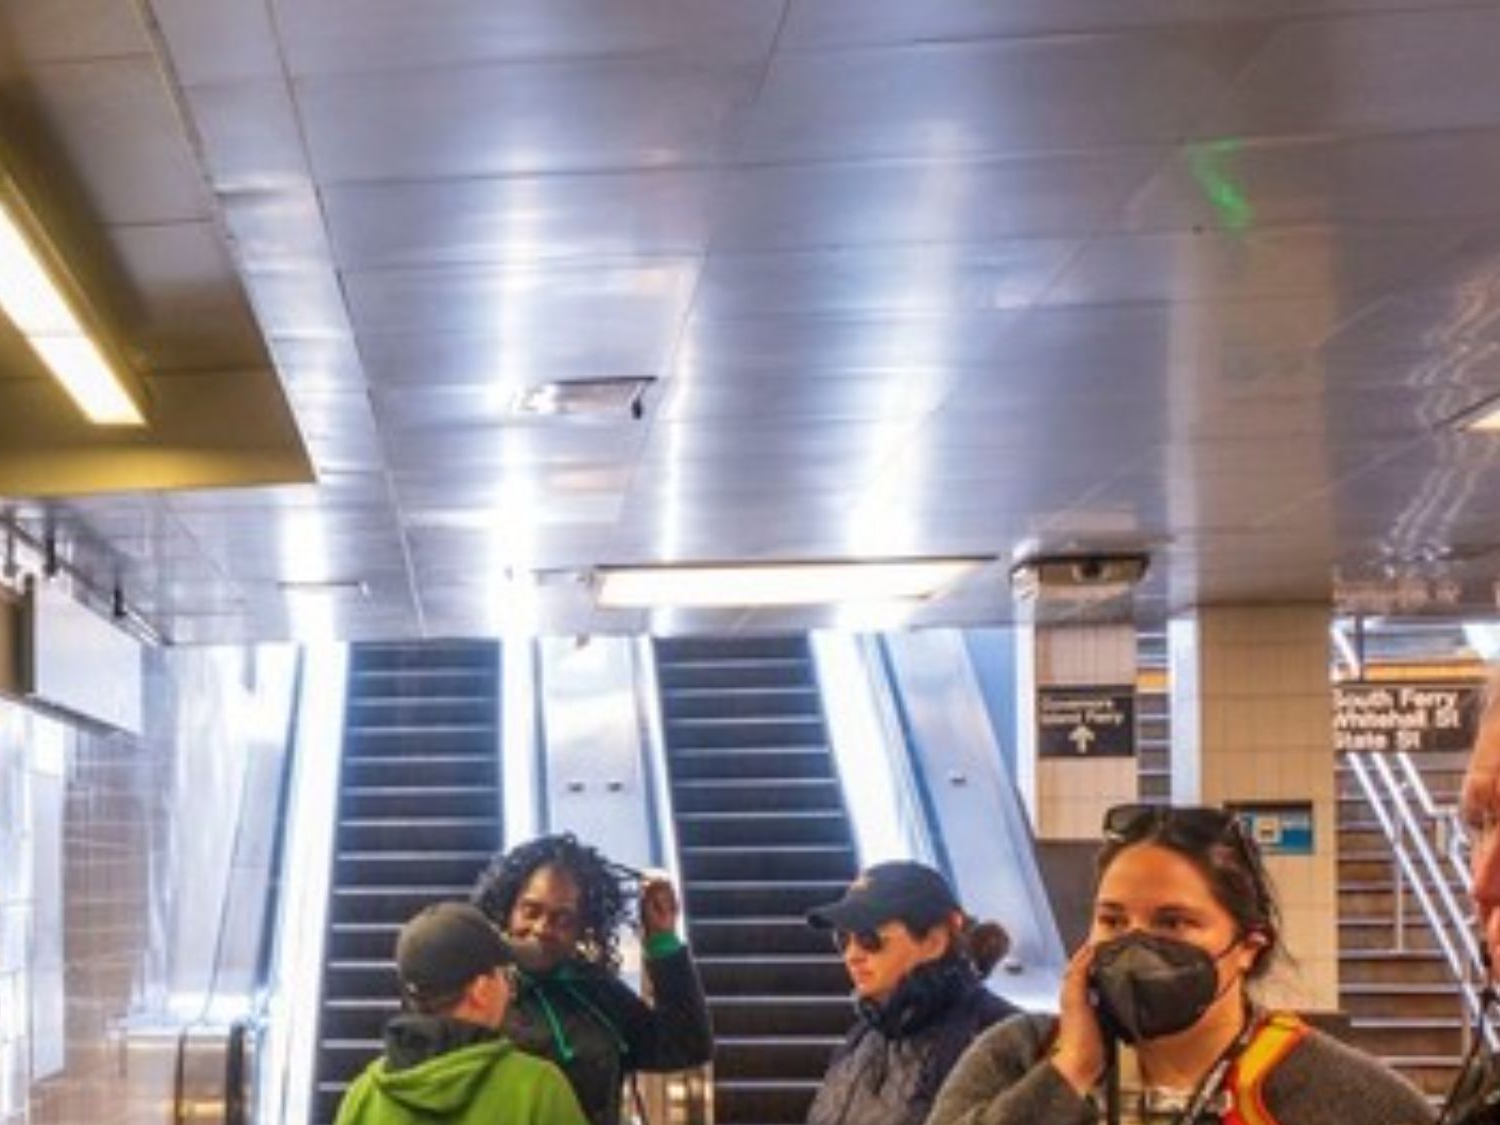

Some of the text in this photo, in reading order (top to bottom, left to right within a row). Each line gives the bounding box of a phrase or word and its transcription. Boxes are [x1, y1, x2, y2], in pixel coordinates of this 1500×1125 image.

[1333, 688, 1458, 709] South Ferry
[1436, 709, 1460, 728] St
[1333, 730, 1421, 748] State St
